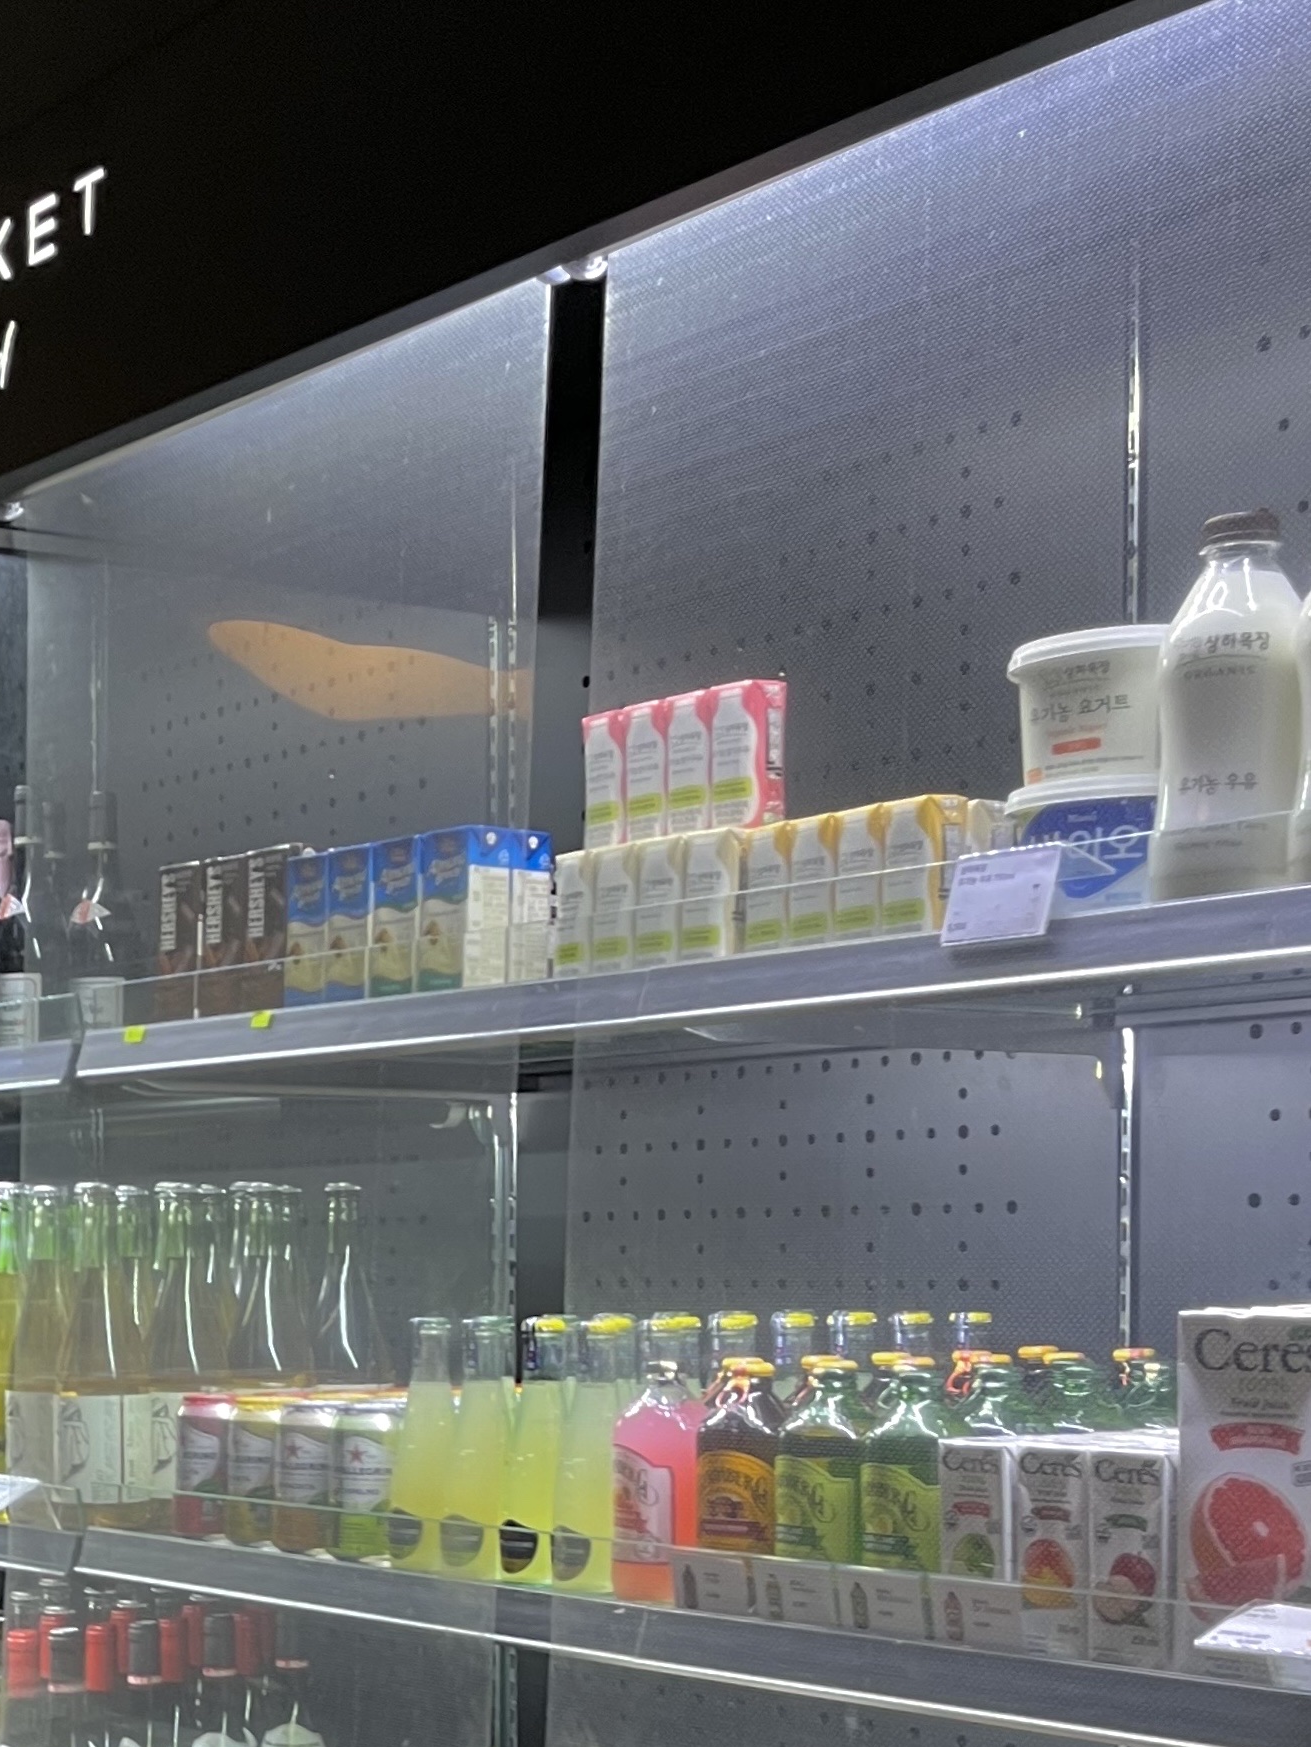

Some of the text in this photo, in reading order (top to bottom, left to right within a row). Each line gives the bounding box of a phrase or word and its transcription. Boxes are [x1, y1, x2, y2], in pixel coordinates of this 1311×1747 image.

[1078, 694, 1132, 716] 요거트
[1224, 771, 1258, 791] 우유
[205, 865, 223, 945] HERSHEY'S
[247, 857, 265, 938] HERSHEY'S
